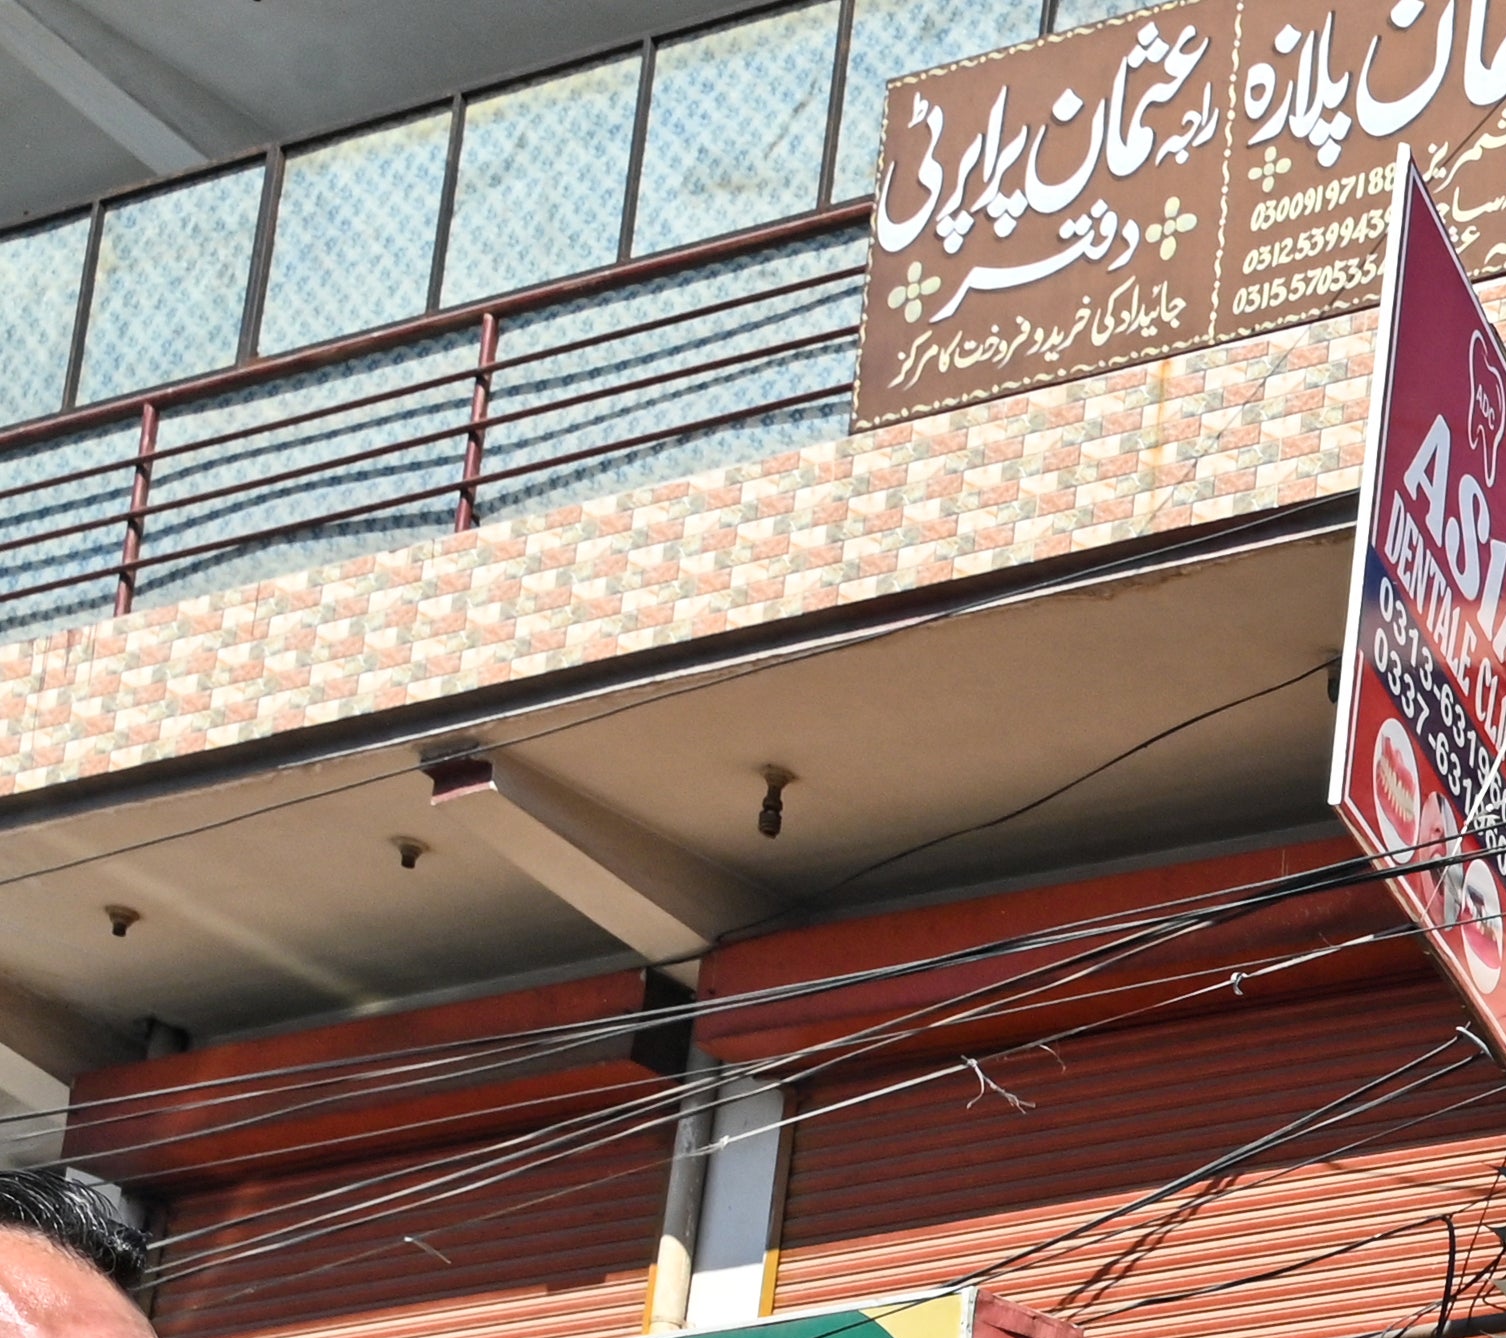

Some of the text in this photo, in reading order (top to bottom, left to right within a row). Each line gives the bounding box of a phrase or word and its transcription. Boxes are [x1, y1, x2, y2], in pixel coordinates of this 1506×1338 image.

[1025, 21, 1209, 214] عثمان
[1156, 82, 1219, 167] راجہ
[1244, 10, 1352, 168] پلازہ
[930, 199, 1140, 323] دفتر
[1475, 383, 1496, 431] ADC
